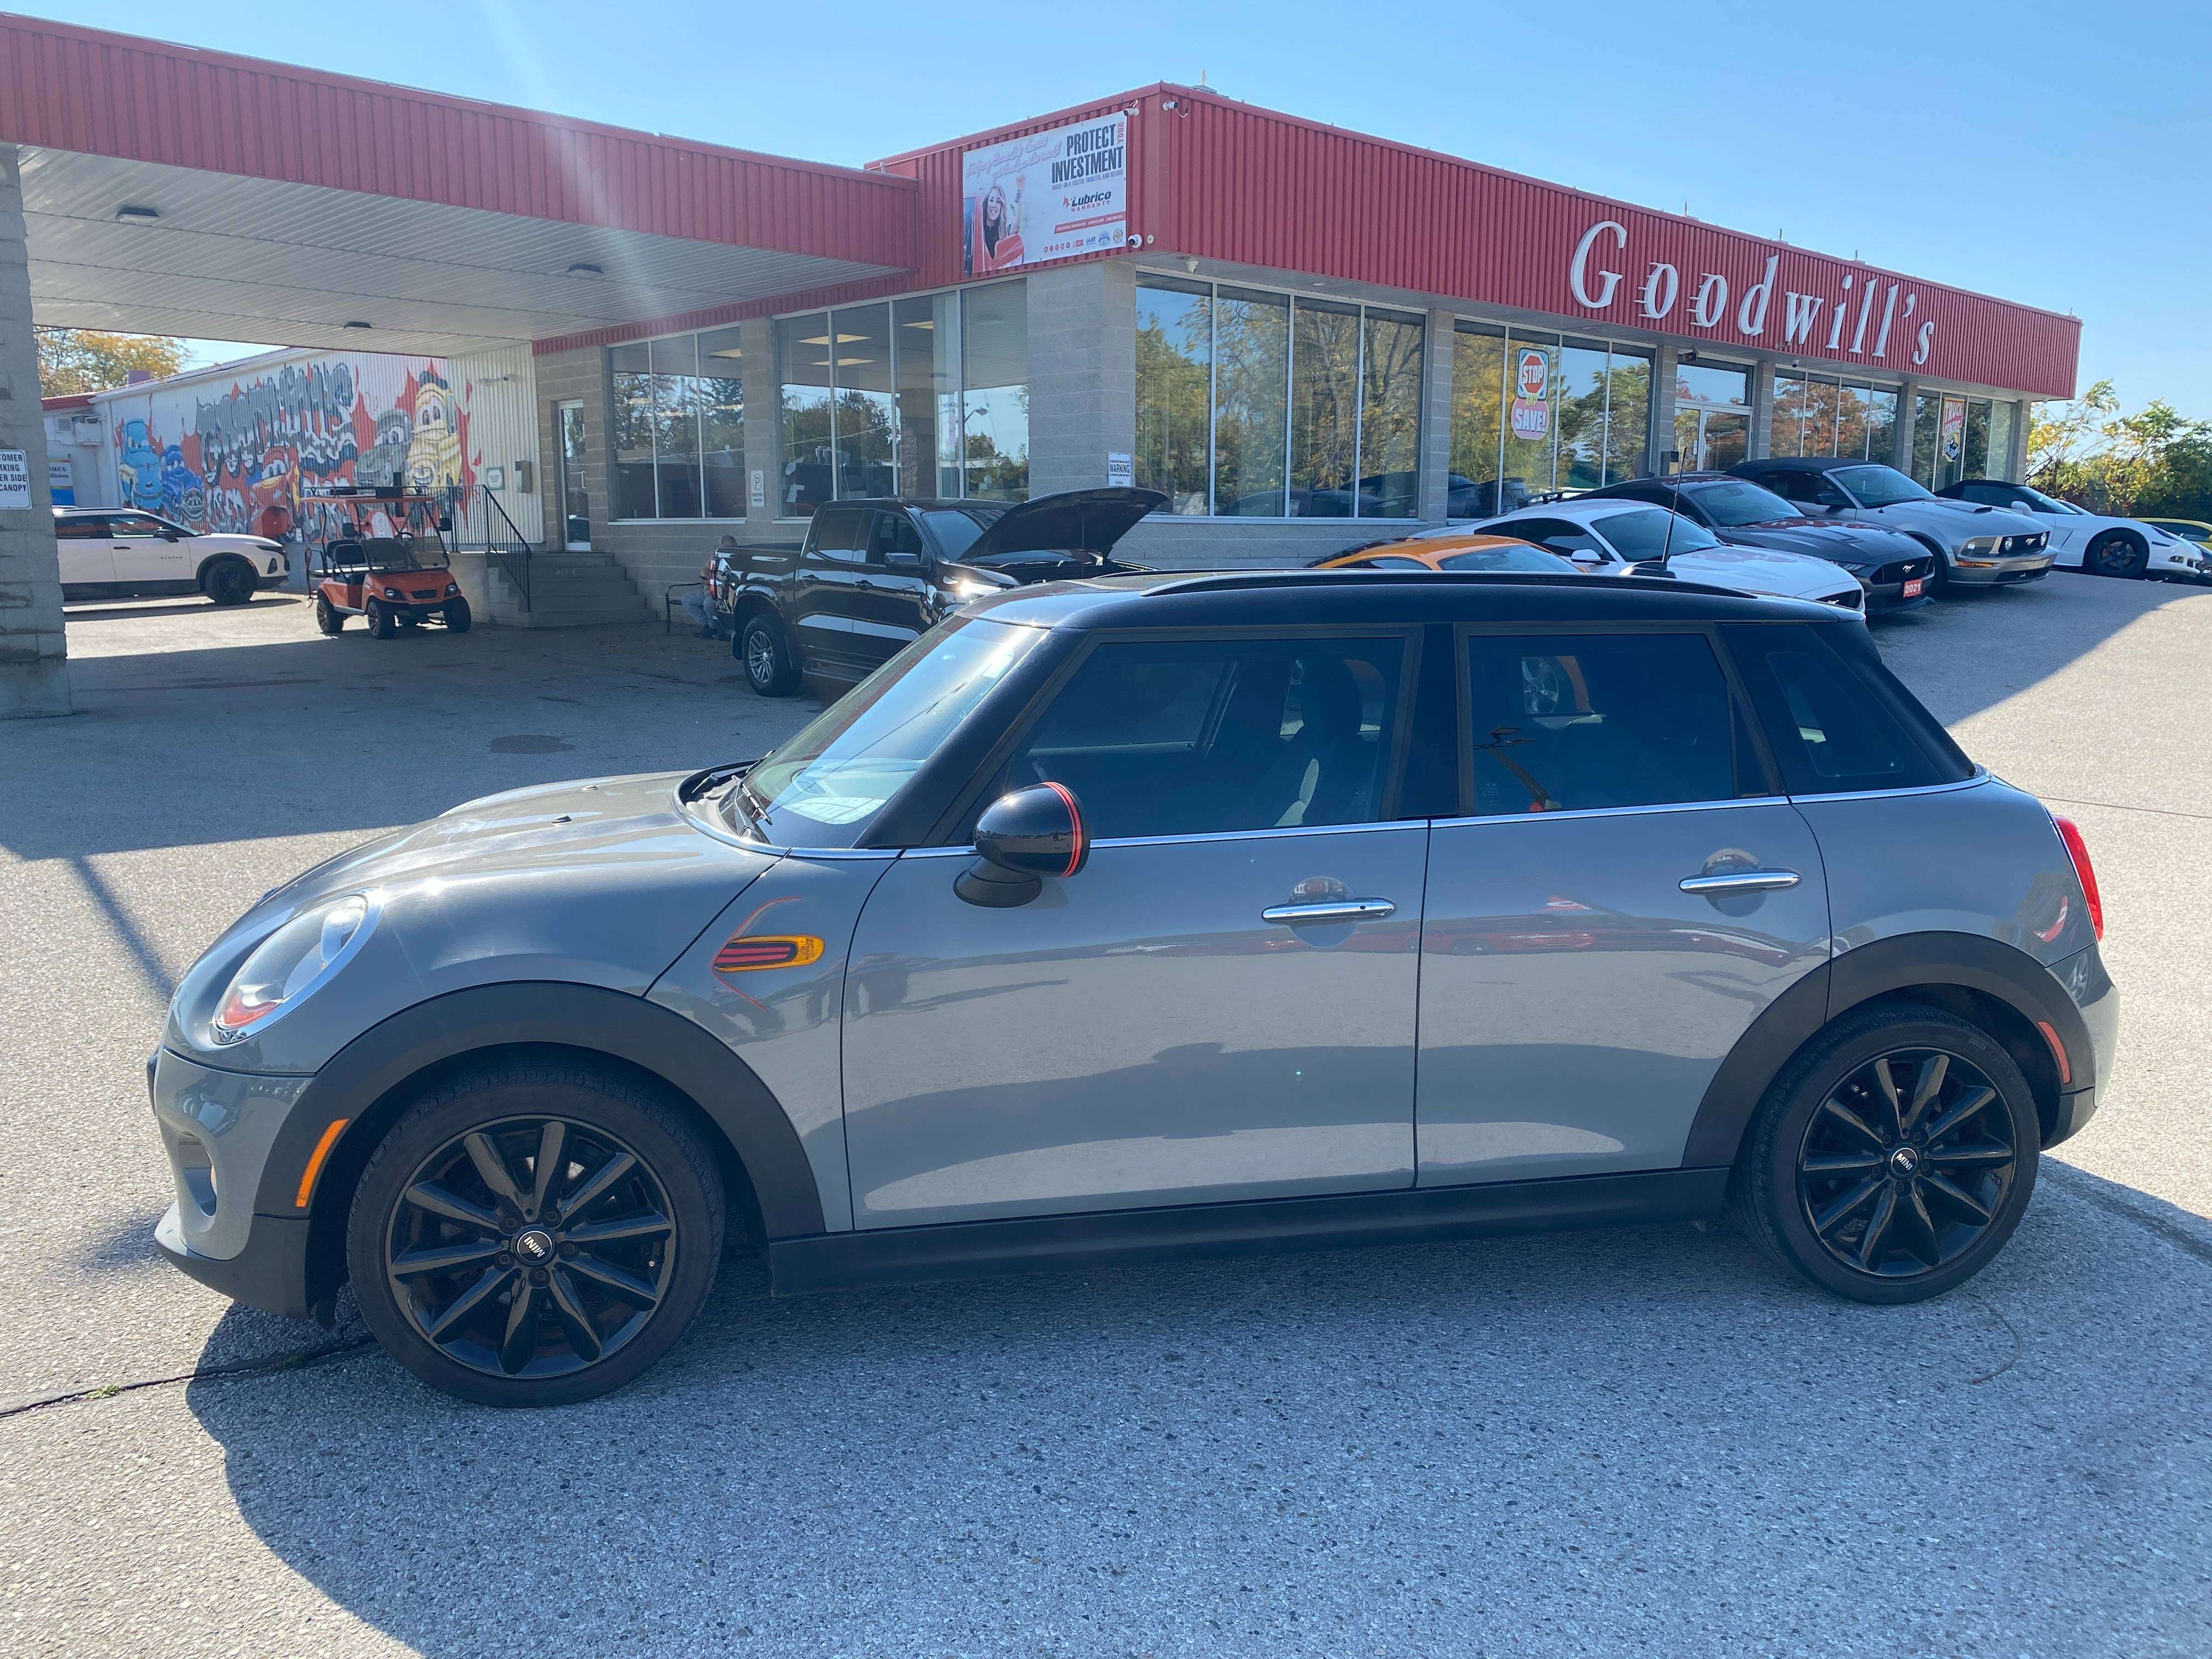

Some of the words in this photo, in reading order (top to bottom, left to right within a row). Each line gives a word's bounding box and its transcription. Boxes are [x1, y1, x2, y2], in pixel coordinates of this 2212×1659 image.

[1066, 123, 1116, 157] PROTECT
[1052, 145, 1124, 183] INVESTMENT
[1071, 191, 1111, 207] Lubrico
[1071, 200, 1110, 213] WARRANTY
[1570, 220, 1934, 366] Goodwill's
[1522, 365, 1544, 384] STOP
[1525, 394, 1538, 407] AND
[1515, 408, 1546, 433] SAVE!
[1110, 464, 1130, 473] WARNING
[0, 484, 26, 492] CANOPY
[1905, 583, 1921, 594] 2021
[1896, 1153, 1914, 1171] MINI
[523, 1236, 545, 1258] MINI
